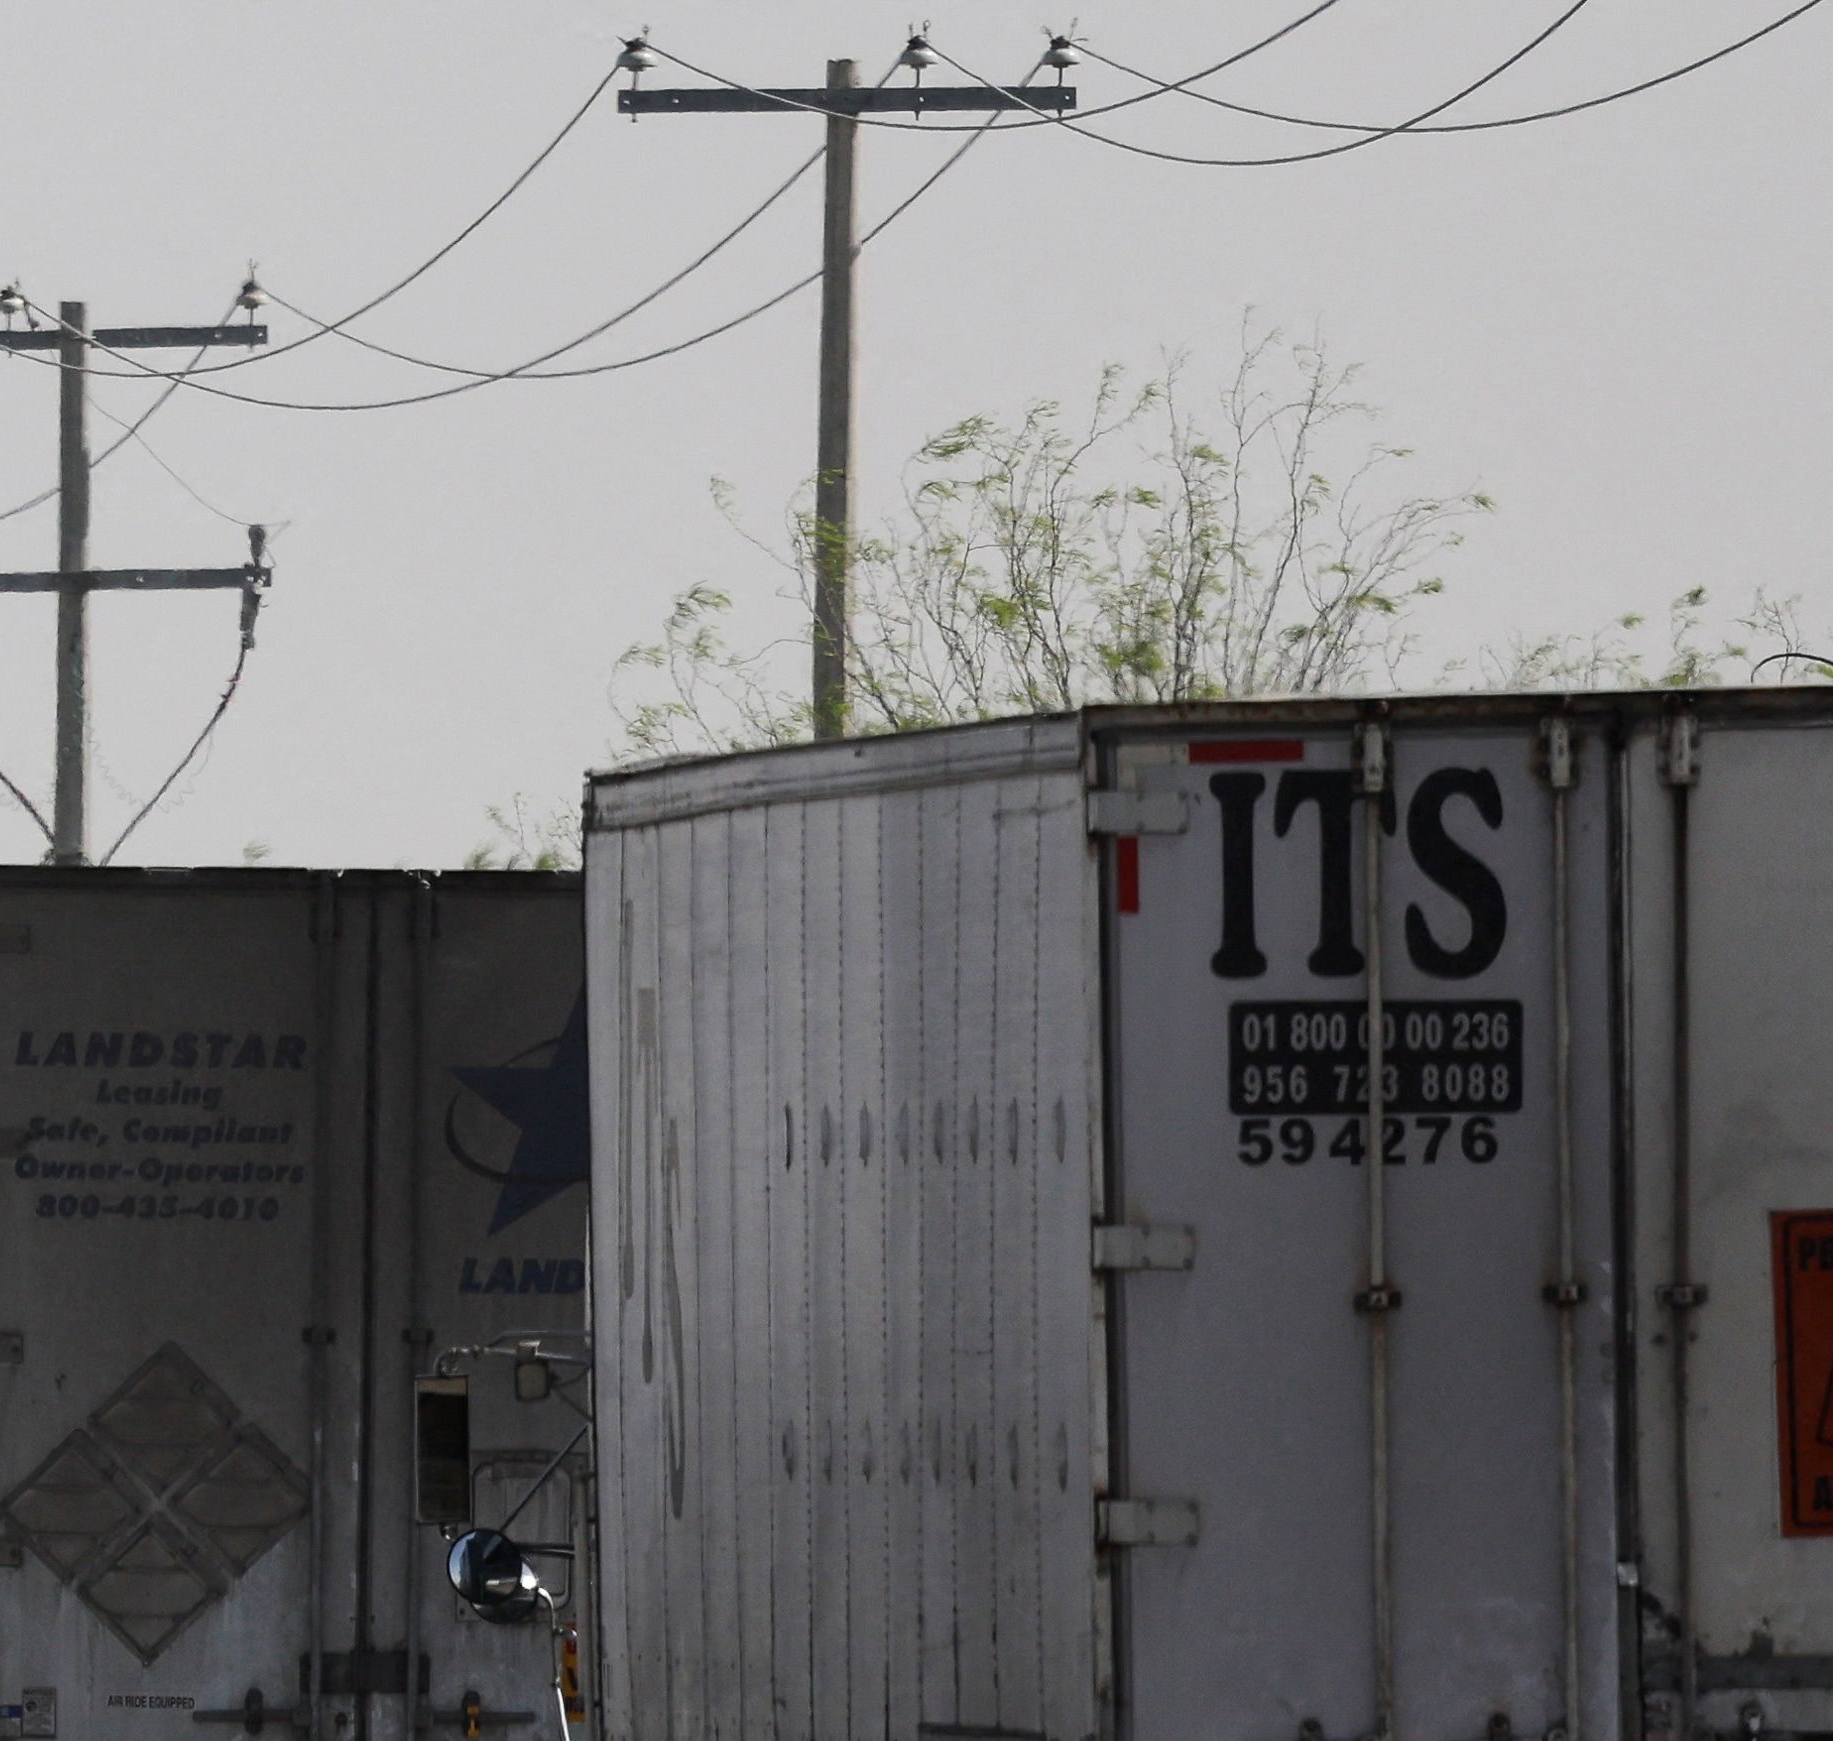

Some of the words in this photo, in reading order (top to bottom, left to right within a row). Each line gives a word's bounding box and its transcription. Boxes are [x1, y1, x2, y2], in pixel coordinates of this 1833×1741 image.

[1208, 765, 1508, 980] ITS
[15, 1031, 308, 1069] LANDSTAR
[1242, 1012, 1277, 1051] 01
[1289, 1012, 1346, 1052] 800
[1406, 1012, 1443, 1051] 00
[1452, 1012, 1510, 1051] 236
[97, 1079, 223, 1111] Leasing
[1243, 1064, 1309, 1104] 956
[1422, 1063, 1510, 1103] 8088
[28, 1116, 109, 1148] Safe,
[122, 1119, 293, 1150] Compliant
[15, 1157, 304, 1187] Owner-Operators
[108, 1695, 124, 1708] AIR
[125, 1696, 147, 1709] RIDE
[148, 1696, 196, 1710] EQUIPPED
